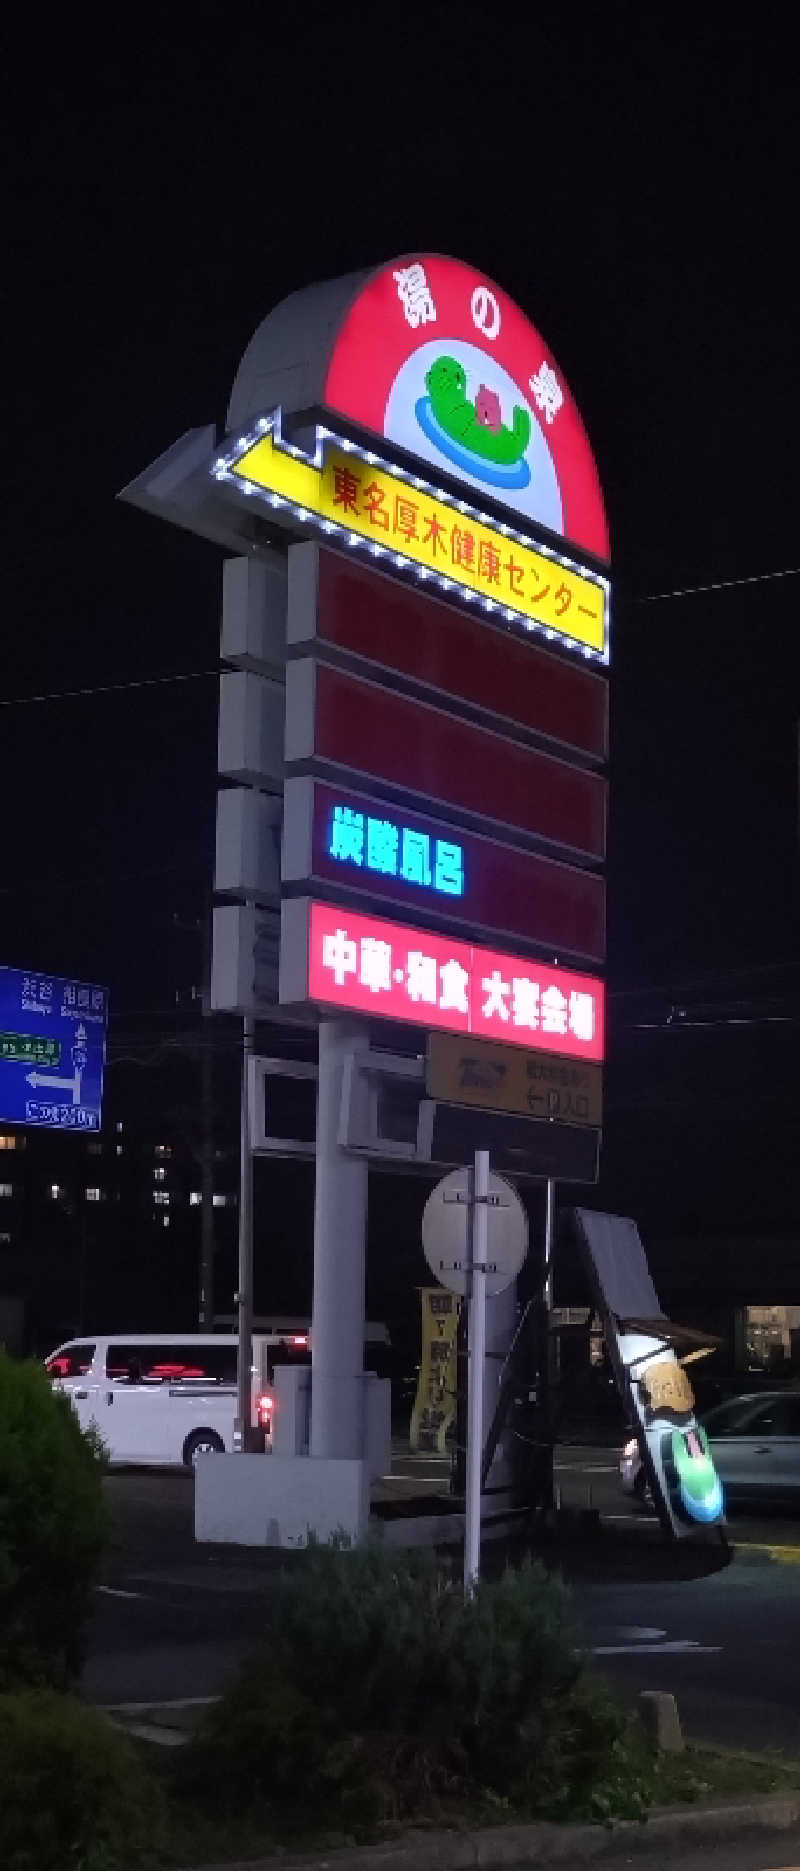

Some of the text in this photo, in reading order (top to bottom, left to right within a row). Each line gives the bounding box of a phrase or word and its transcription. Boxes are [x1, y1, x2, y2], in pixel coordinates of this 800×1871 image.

[333, 466, 598, 618] 東名厚木健康センター
[330, 806, 463, 896] 炭酸風呂
[481, 971, 595, 1041] 大宴会場
